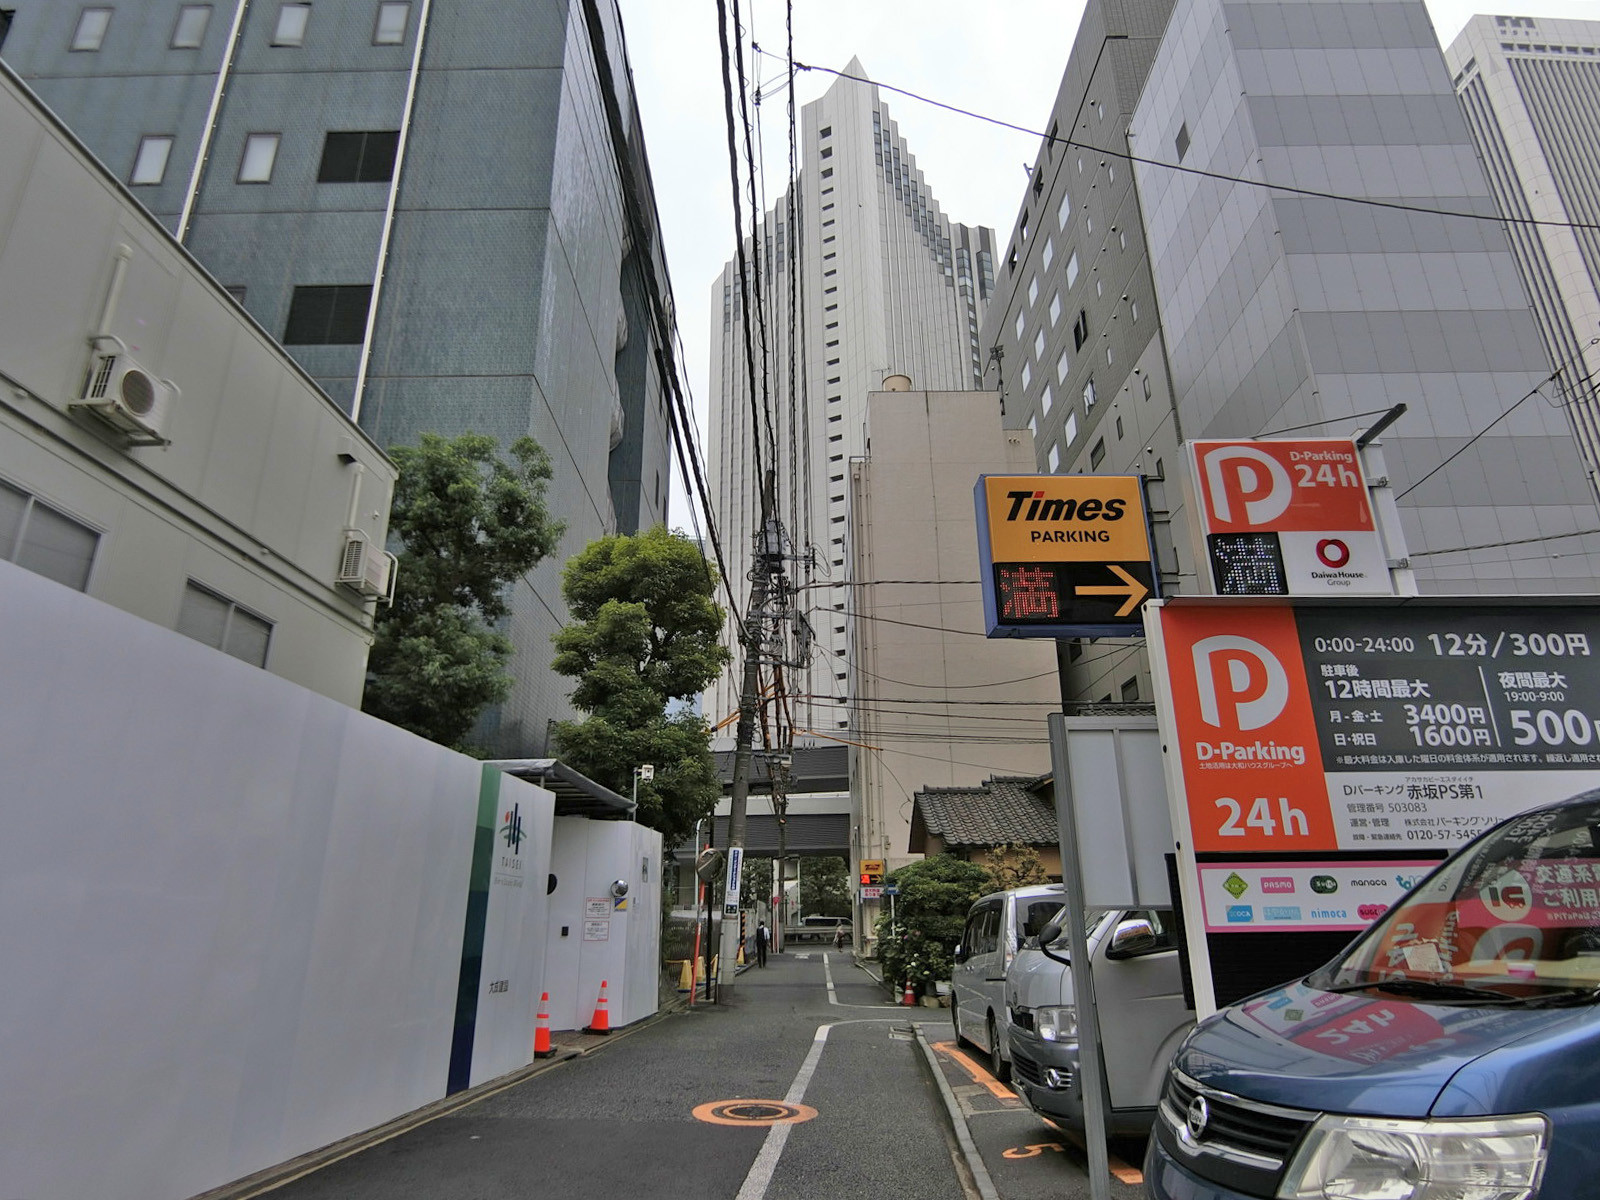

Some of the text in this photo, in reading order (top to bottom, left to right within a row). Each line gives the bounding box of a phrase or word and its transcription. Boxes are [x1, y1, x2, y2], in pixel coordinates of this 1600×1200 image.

[1289, 451, 1353, 463] D-Parking
[1293, 464, 1358, 488] 24h
[1006, 490, 1126, 522] Times
[1030, 530, 1110, 543] PARKING
[1327, 579, 1351, 587] Group
[1000, 566, 1060, 619] 満
[1314, 637, 1415, 653] 0:00-24:00
[1320, 664, 1360, 677] 駐車後
[1497, 671, 1568, 689] 夜間最大
[1325, 679, 1431, 699] 12時間最大
[1504, 691, 1565, 702] 19:00-9:00
[1403, 703, 1487, 725] 3400円
[1409, 725, 1492, 747] 1600円
[1195, 740, 1306, 765] D-Parking
[1406, 783, 1484, 800] 赤坂PS第1
[1347, 802, 1428, 813] 管理番号 503083
[1214, 797, 1309, 836] 24h
[1351, 879, 1387, 887] manaca
[1310, 907, 1347, 919] nimoca
